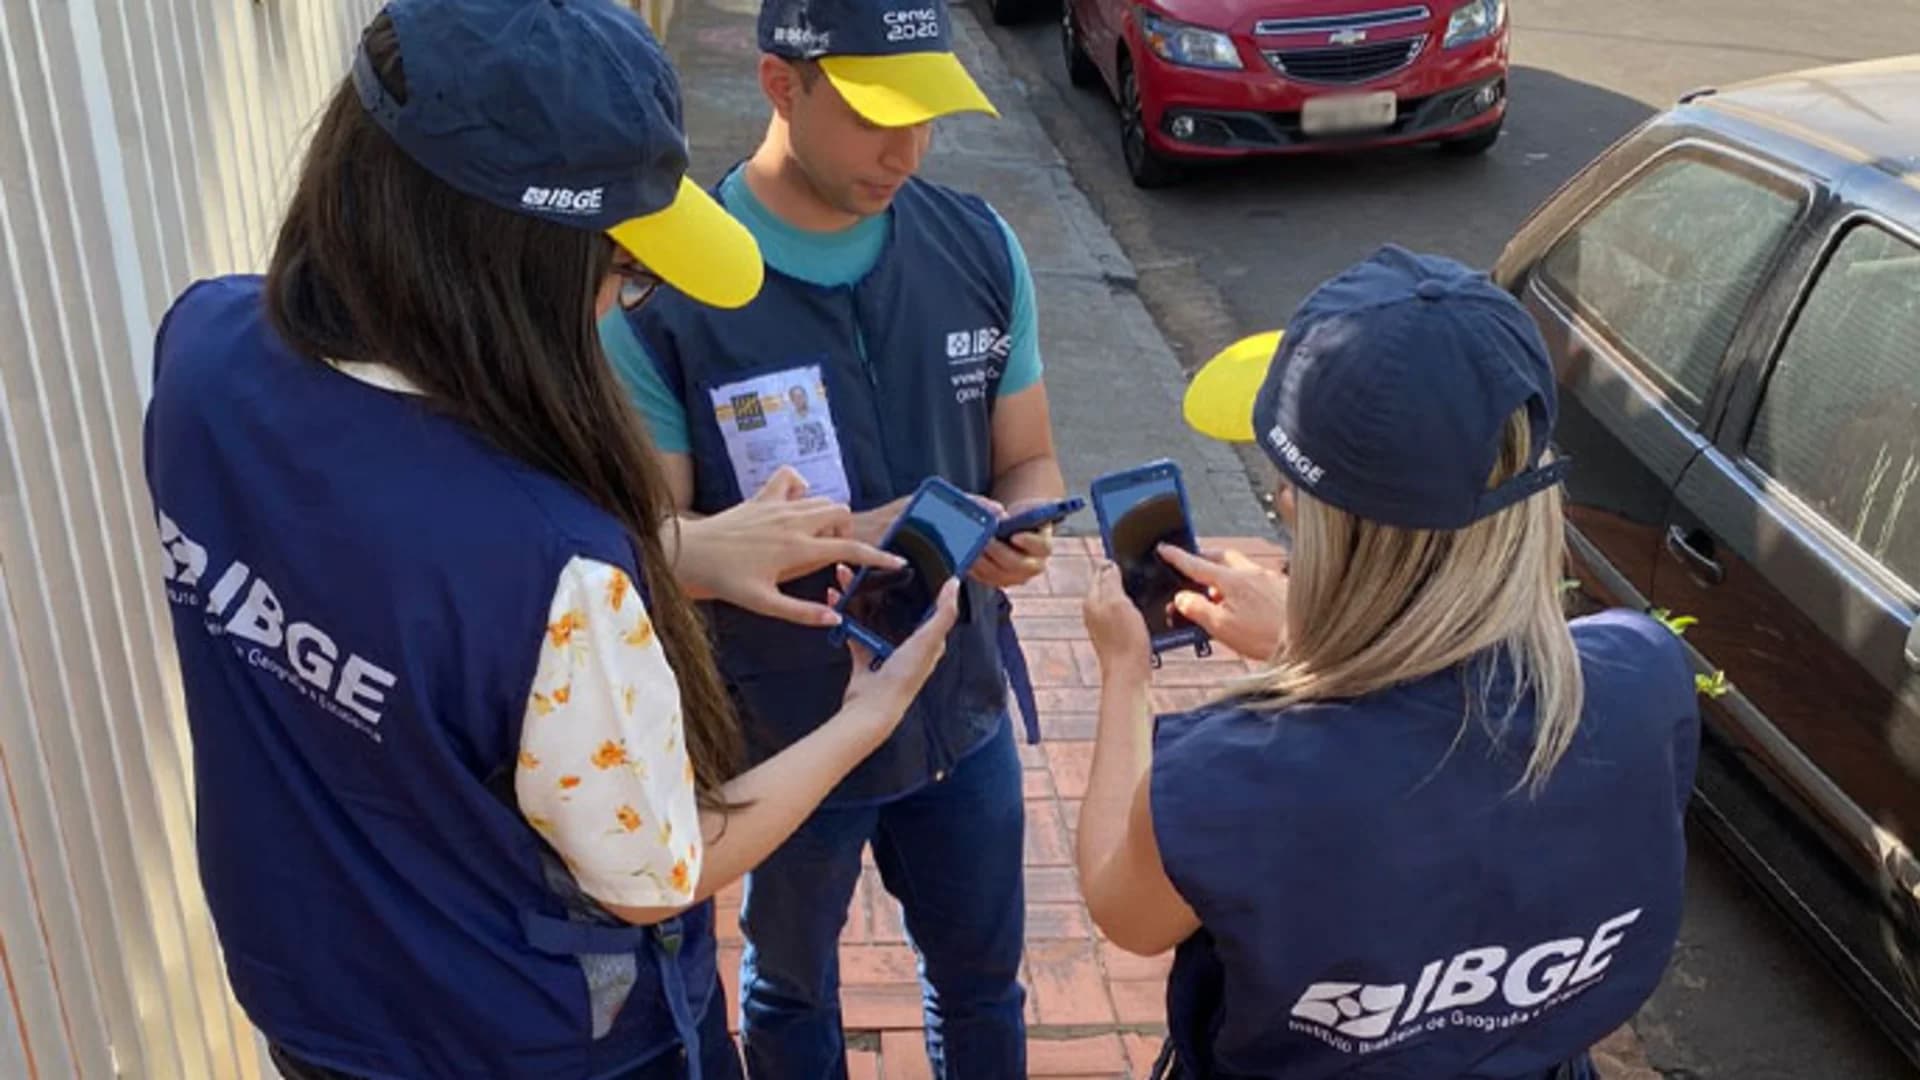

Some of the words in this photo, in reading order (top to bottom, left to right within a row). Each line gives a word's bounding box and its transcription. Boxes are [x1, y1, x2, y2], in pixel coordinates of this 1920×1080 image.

[883, 8, 936, 24] censo
[886, 22, 939, 42] 2020
[548, 187, 604, 209] IBGE
[1281, 441, 1326, 483] IBGE
[206, 560, 397, 725] IBGE
[1399, 907, 1642, 1025] IBGE
